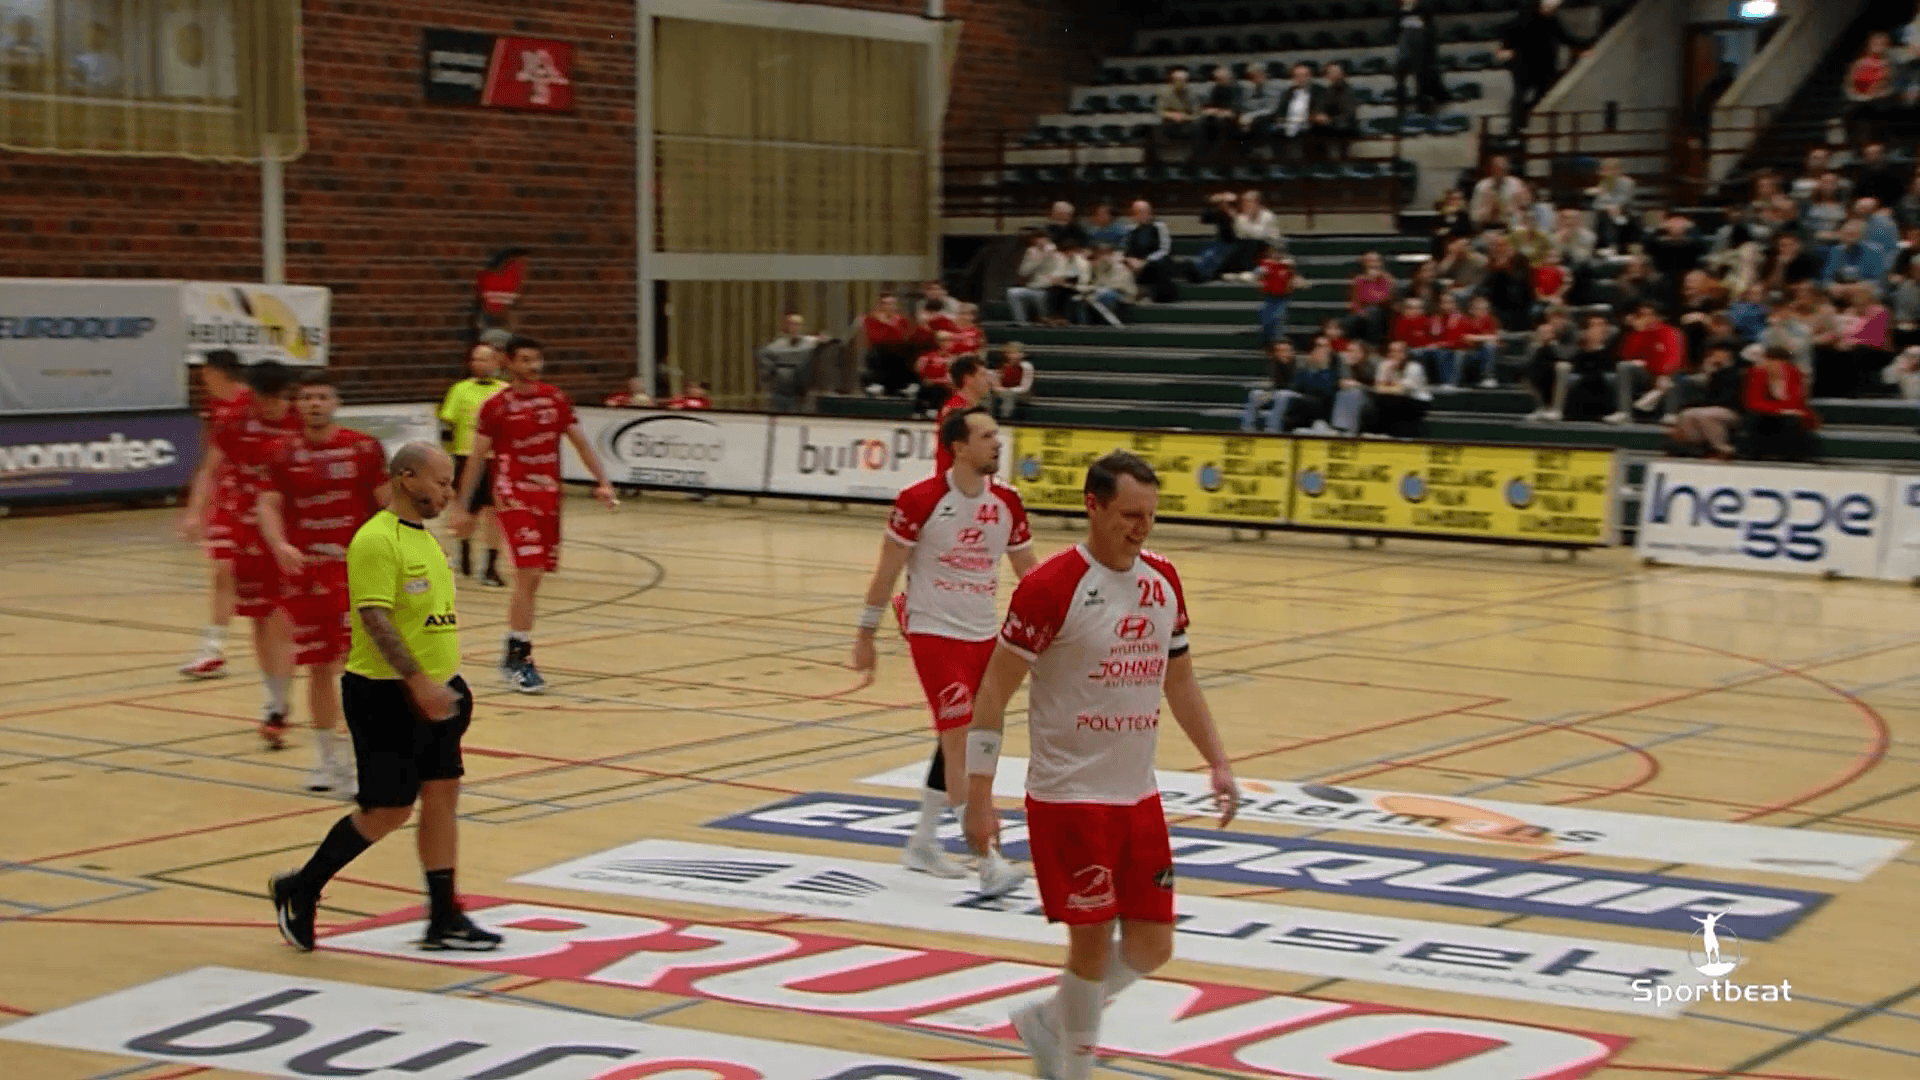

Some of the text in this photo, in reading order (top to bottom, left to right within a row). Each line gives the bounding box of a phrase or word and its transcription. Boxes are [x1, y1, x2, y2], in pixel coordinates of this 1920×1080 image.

[977, 504, 999, 524] 44
[1138, 578, 1167, 607] 24
[1110, 642, 1159, 656] HYUNDA
[1077, 715, 1153, 732] POLYTEX
[748, 801, 1801, 916] EUOQUIP
[314, 902, 1612, 1080] BRUNO
